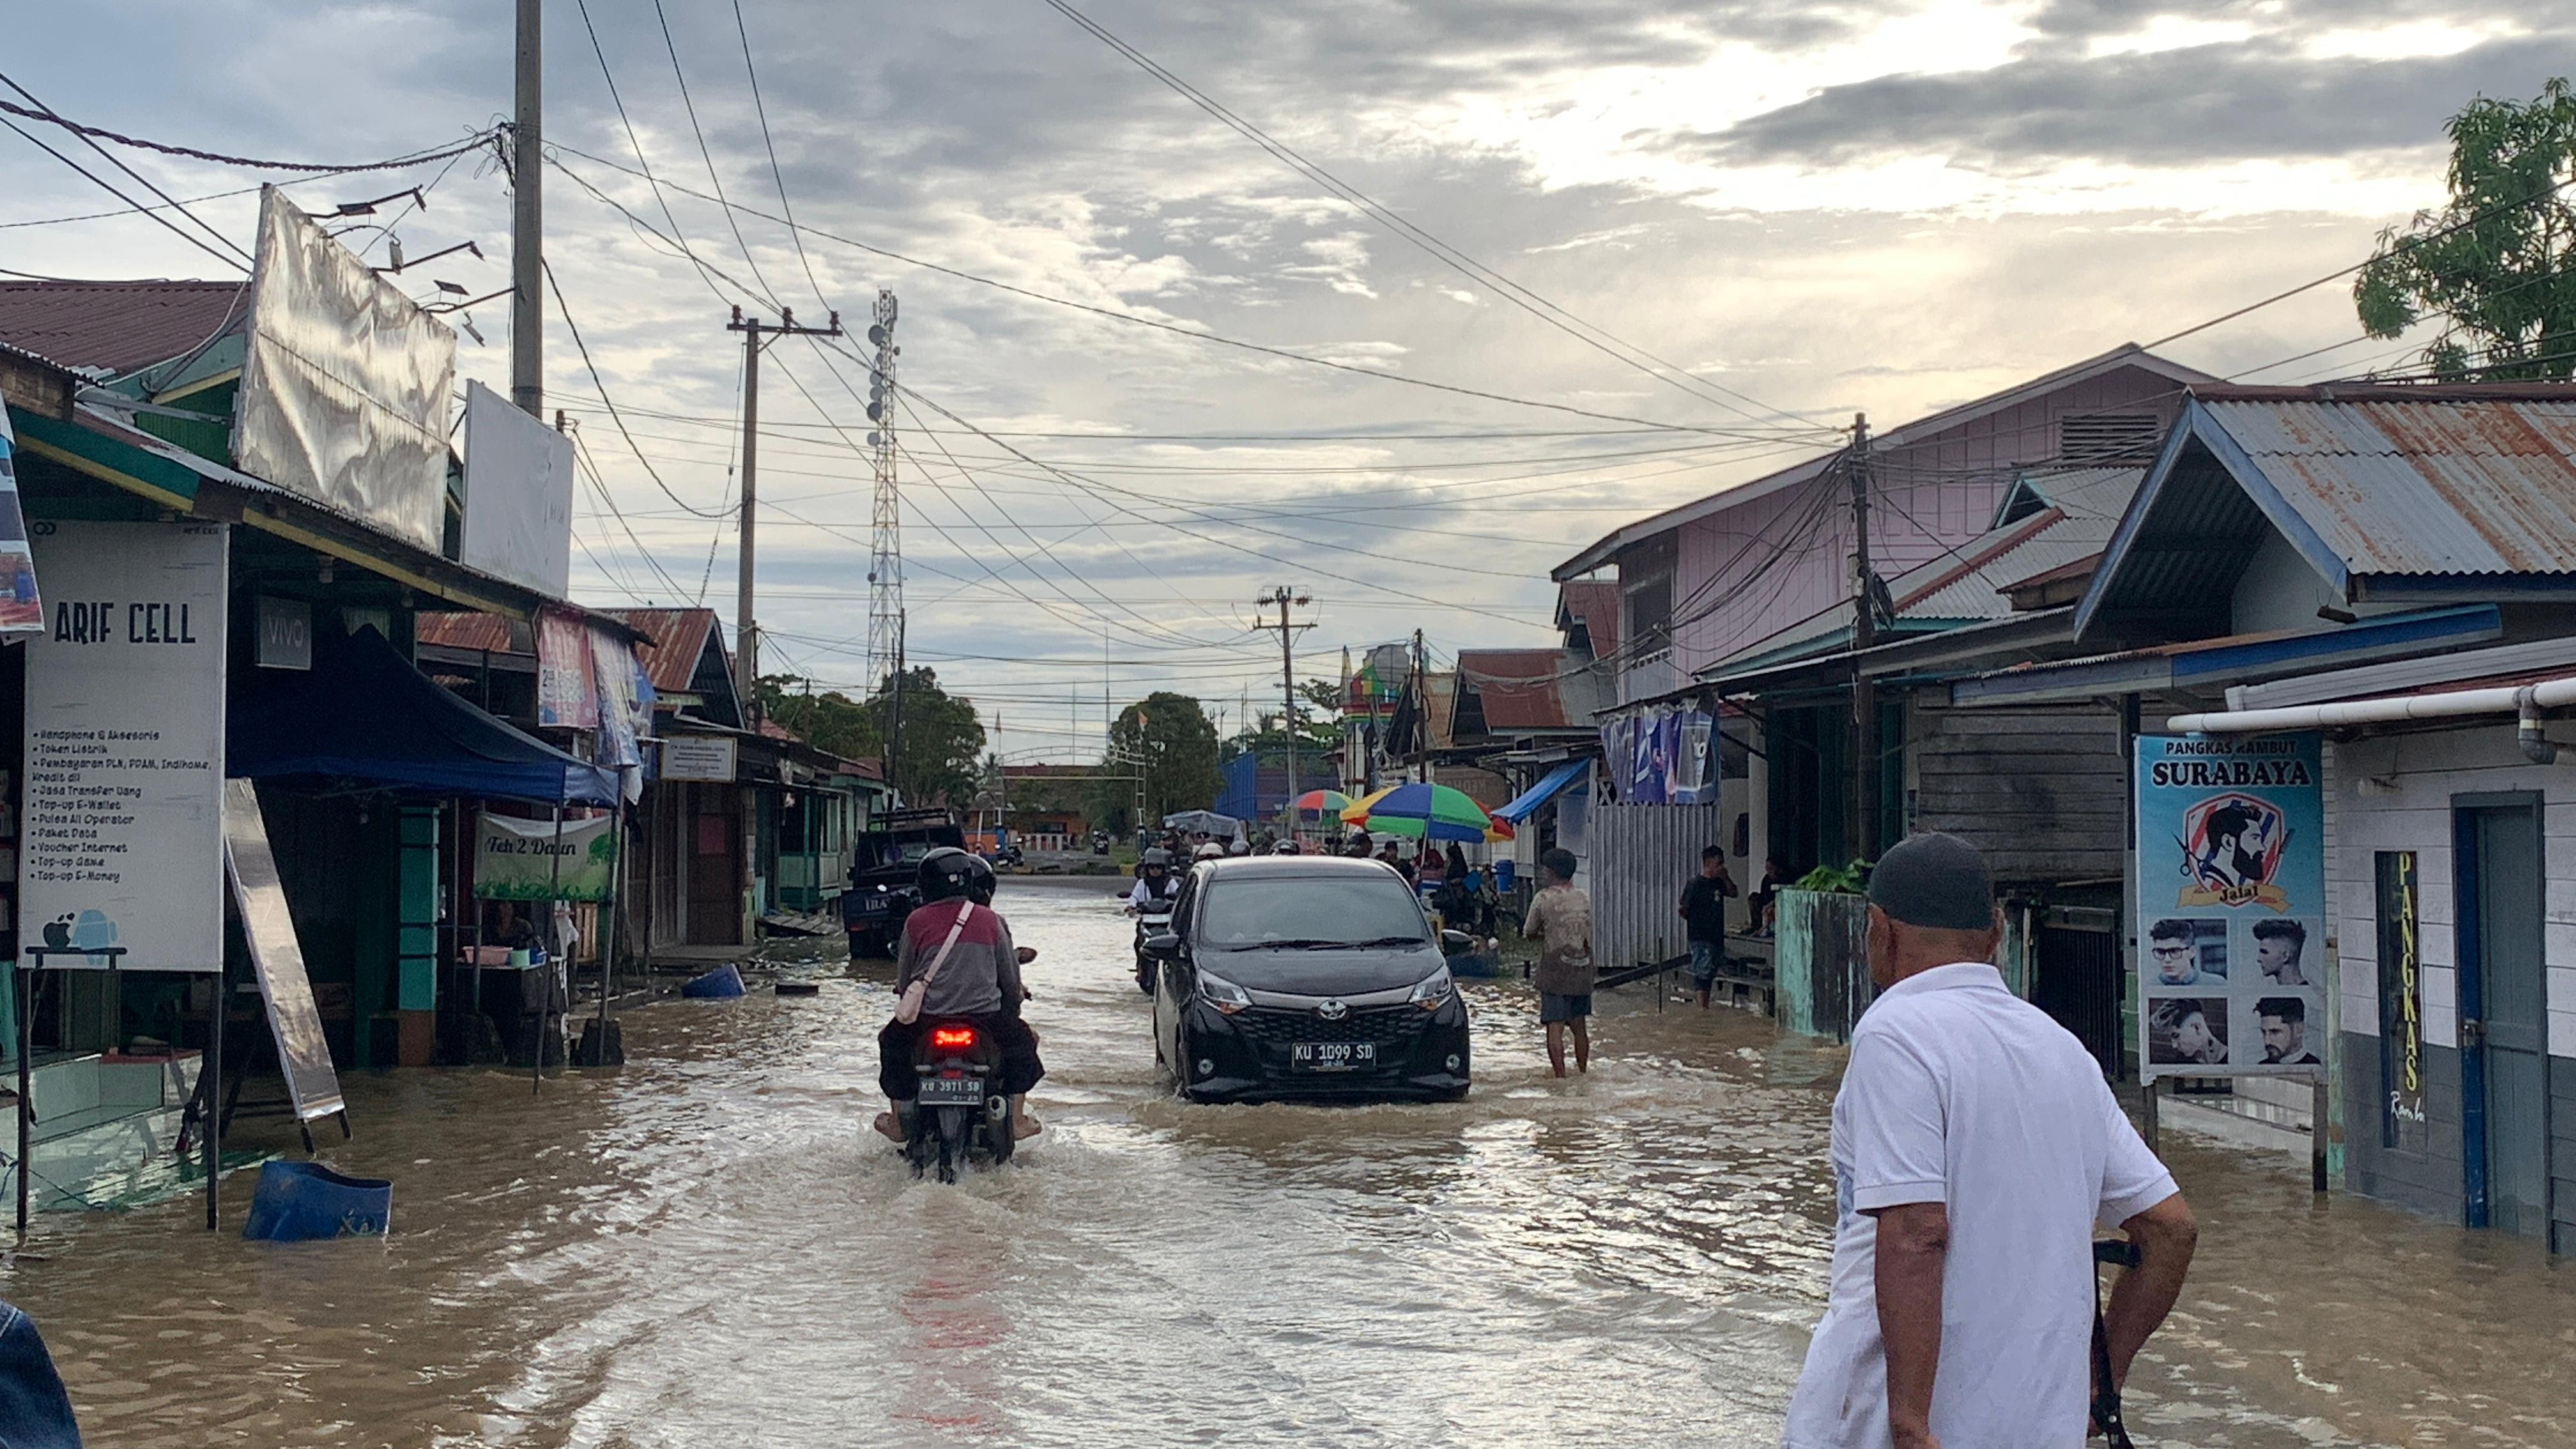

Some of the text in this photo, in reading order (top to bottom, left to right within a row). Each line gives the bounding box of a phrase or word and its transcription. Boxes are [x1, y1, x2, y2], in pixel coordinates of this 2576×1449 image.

[54, 602, 196, 644] ARIF CELL
[107, 730, 159, 740] Aksesoris
[40, 744, 108, 754] Token Listrik
[2166, 742, 2232, 755] PANGKAS
[40, 758, 103, 770] Pembayaran
[32, 772, 65, 782] Kredit
[2152, 761, 2312, 787] SURABAYA
[40, 785, 141, 799] Jasa Transfer Uang
[39, 799, 121, 811] Top-up E-Wallet
[39, 814, 135, 825] Pulsa All Operator
[38, 828, 97, 838] Paket Data
[38, 842, 128, 853] Voucher Internet
[517, 838, 527, 854] 2
[38, 856, 105, 868] Top-up Game
[38, 870, 120, 884] Top-up E-Money
[2220, 885, 2258, 901] Jalal
[2398, 852, 2418, 1092] PANGKAS
[1295, 1044, 1373, 1061] KU 1099 SD
